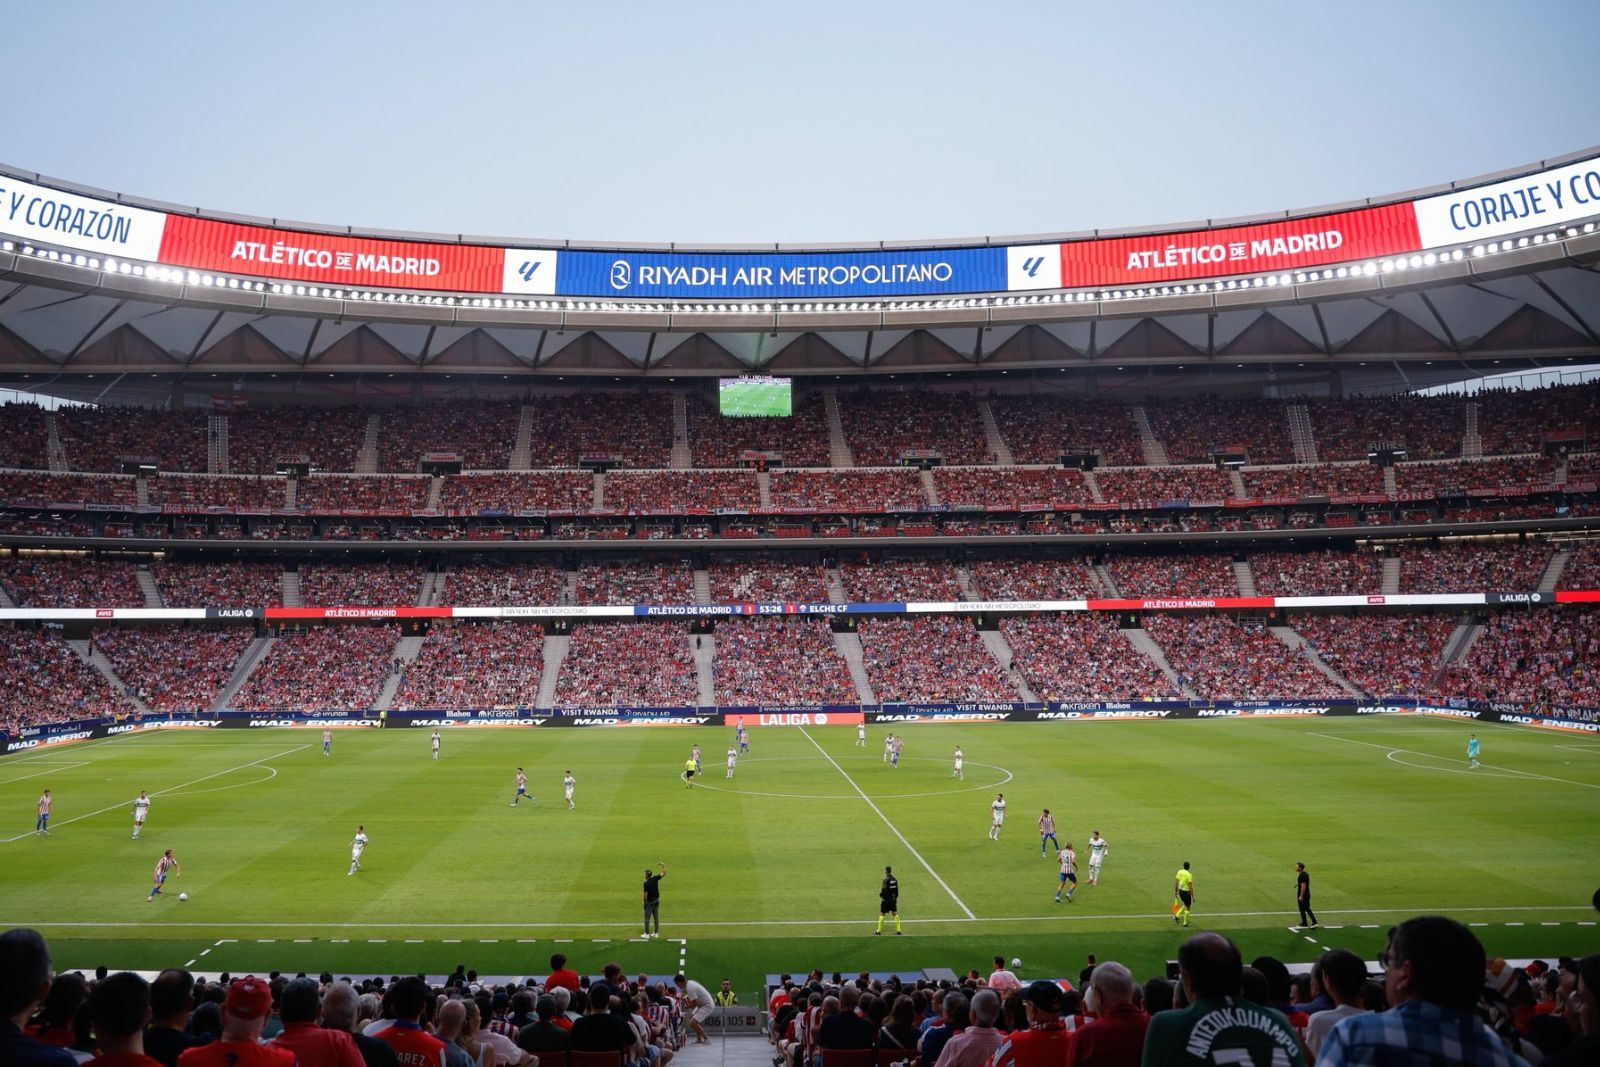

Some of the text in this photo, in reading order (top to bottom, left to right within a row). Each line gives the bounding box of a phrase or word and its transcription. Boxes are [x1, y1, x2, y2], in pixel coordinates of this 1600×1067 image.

[1449, 185, 1549, 232] CORAJE
[1549, 180, 1564, 211] Y
[8, 191, 131, 245] Y CORAZÓN
[1126, 230, 1343, 271] ATLÉTICO DE MADRID
[230, 240, 440, 277] ATLÉTICO DE MADRID
[639, 262, 952, 287] RIYADH AIR METROPOLITANO
[1500, 594, 1529, 602] LALIGA
[759, 605, 782, 613] 53:26
[809, 605, 836, 613] ELCHE
[1143, 600, 1177, 608] ATLÉTICO
[325, 608, 359, 617] ATLÉTICO
[367, 609, 397, 617] MADRID
[648, 605, 685, 615] ATLÉTICO
[699, 606, 732, 614] MADRID
[1068, 702, 1101, 710] kraken
[487, 709, 518, 717] kraken
[583, 708, 619, 716] RWANDA
[1357, 706, 1401, 714] MAD
[1414, 706, 1481, 719] ENERGY
[249, 719, 382, 727] MAD ENERGY
[467, 718, 547, 726] ENERGY
[760, 713, 811, 726] LALIGA
[1500, 714, 1533, 725] MAD
[107, 720, 223, 734] MAD ENERGY
[7, 731, 94, 751] MAD ENERGY
[727, 1016, 744, 1026] 105
[1186, 1007, 1299, 1060] ANTETOKOUNMPO
